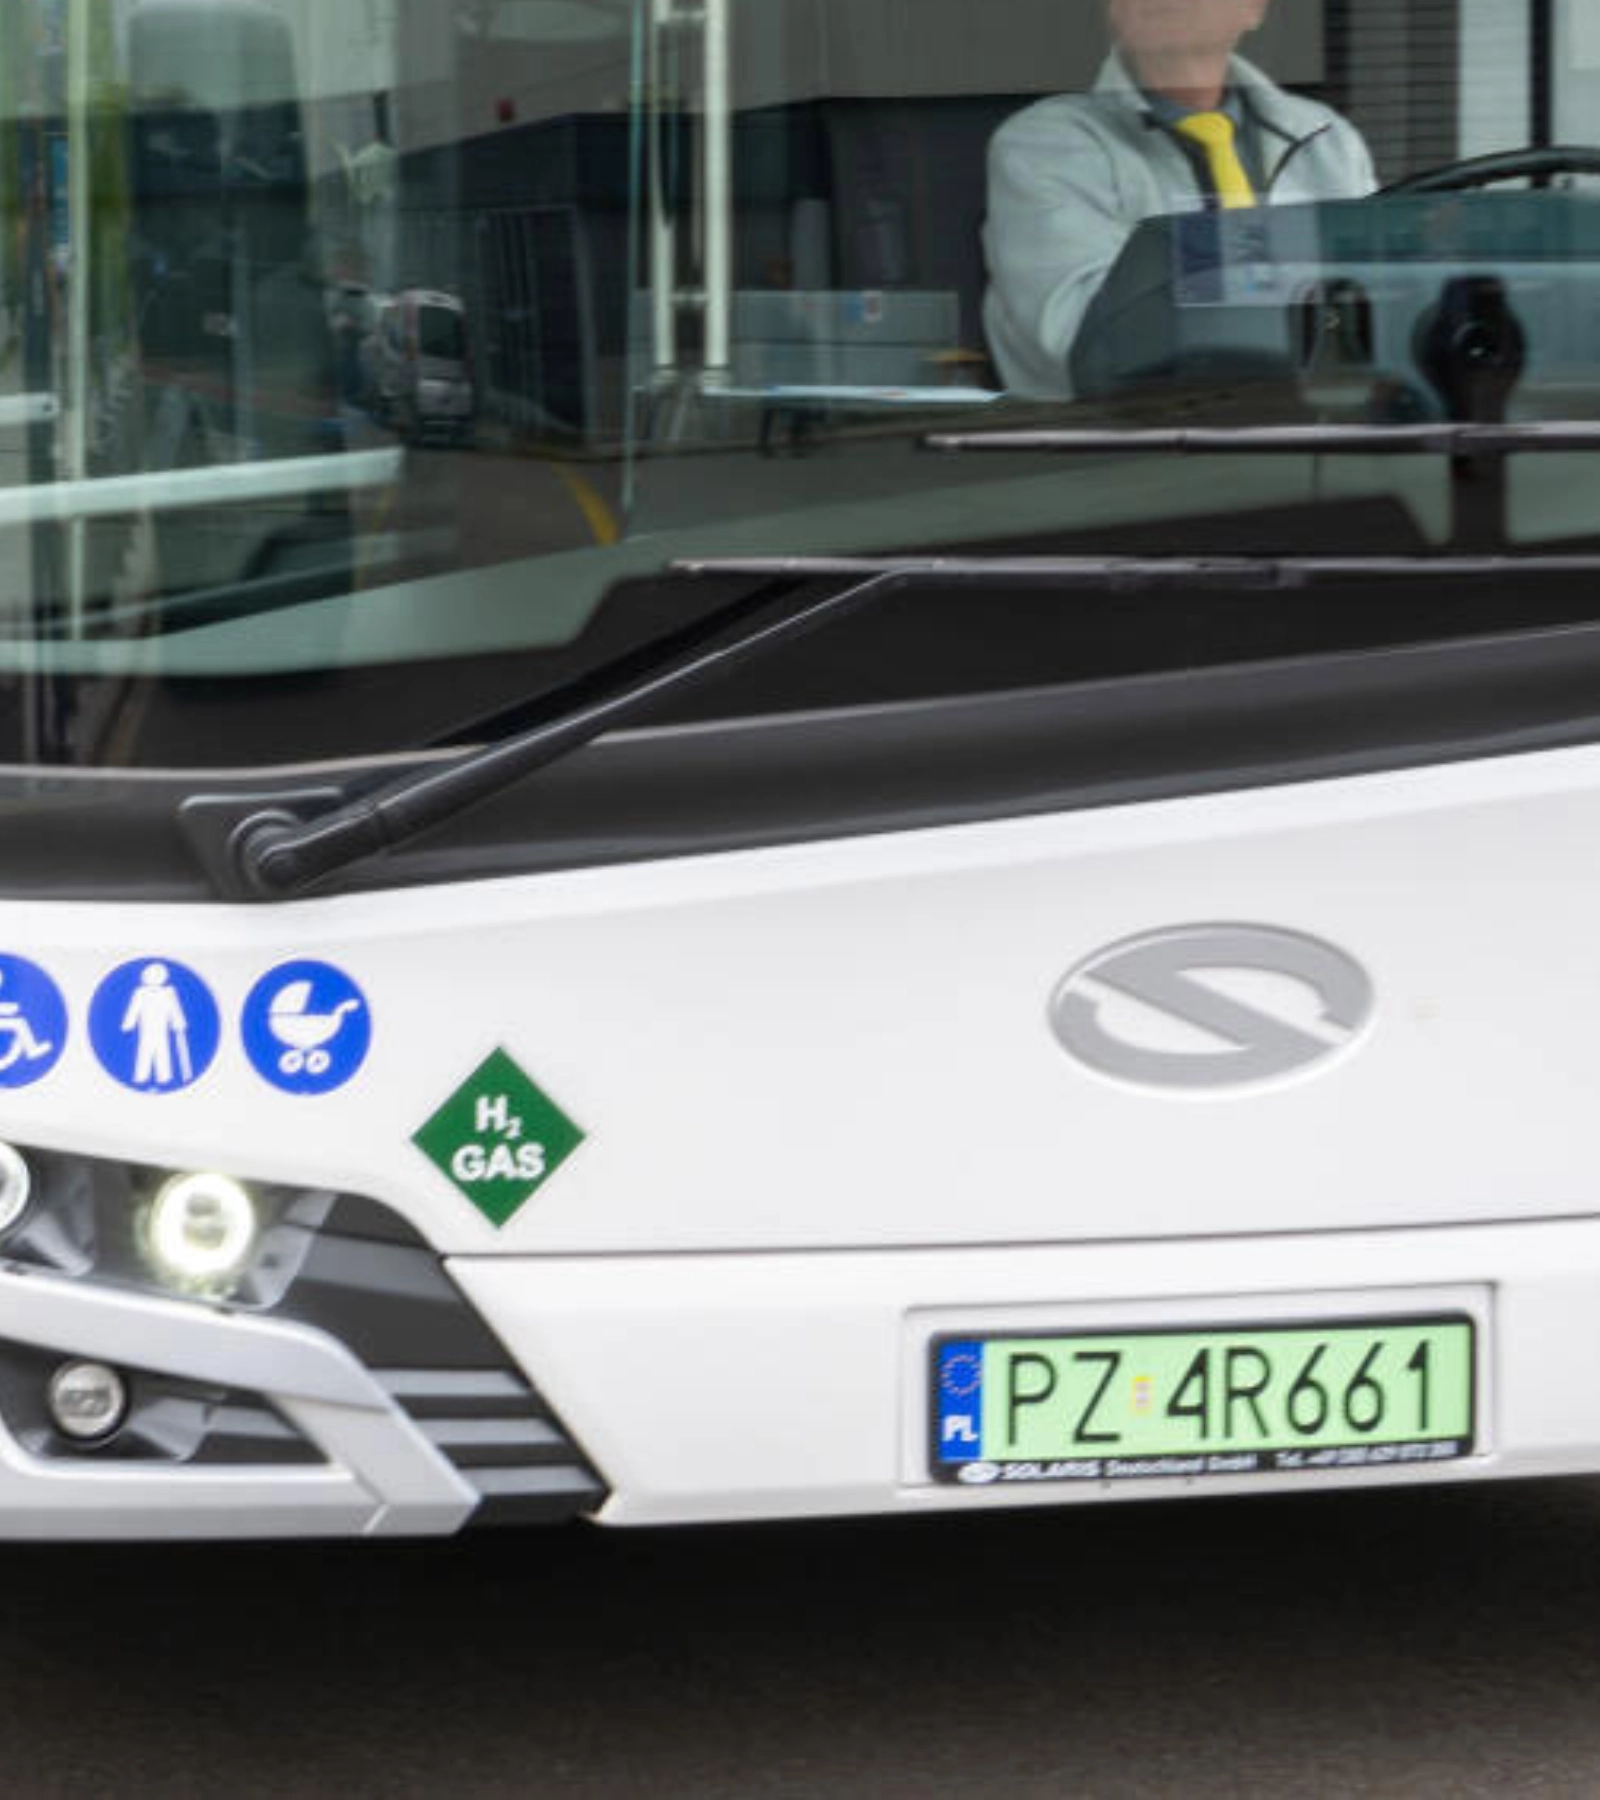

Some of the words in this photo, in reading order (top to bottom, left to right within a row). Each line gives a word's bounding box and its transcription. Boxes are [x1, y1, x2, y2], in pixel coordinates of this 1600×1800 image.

[452, 1142, 546, 1181] GAS
[1008, 1352, 1123, 1444] PZ
[1166, 1340, 1432, 1440] 4R661
